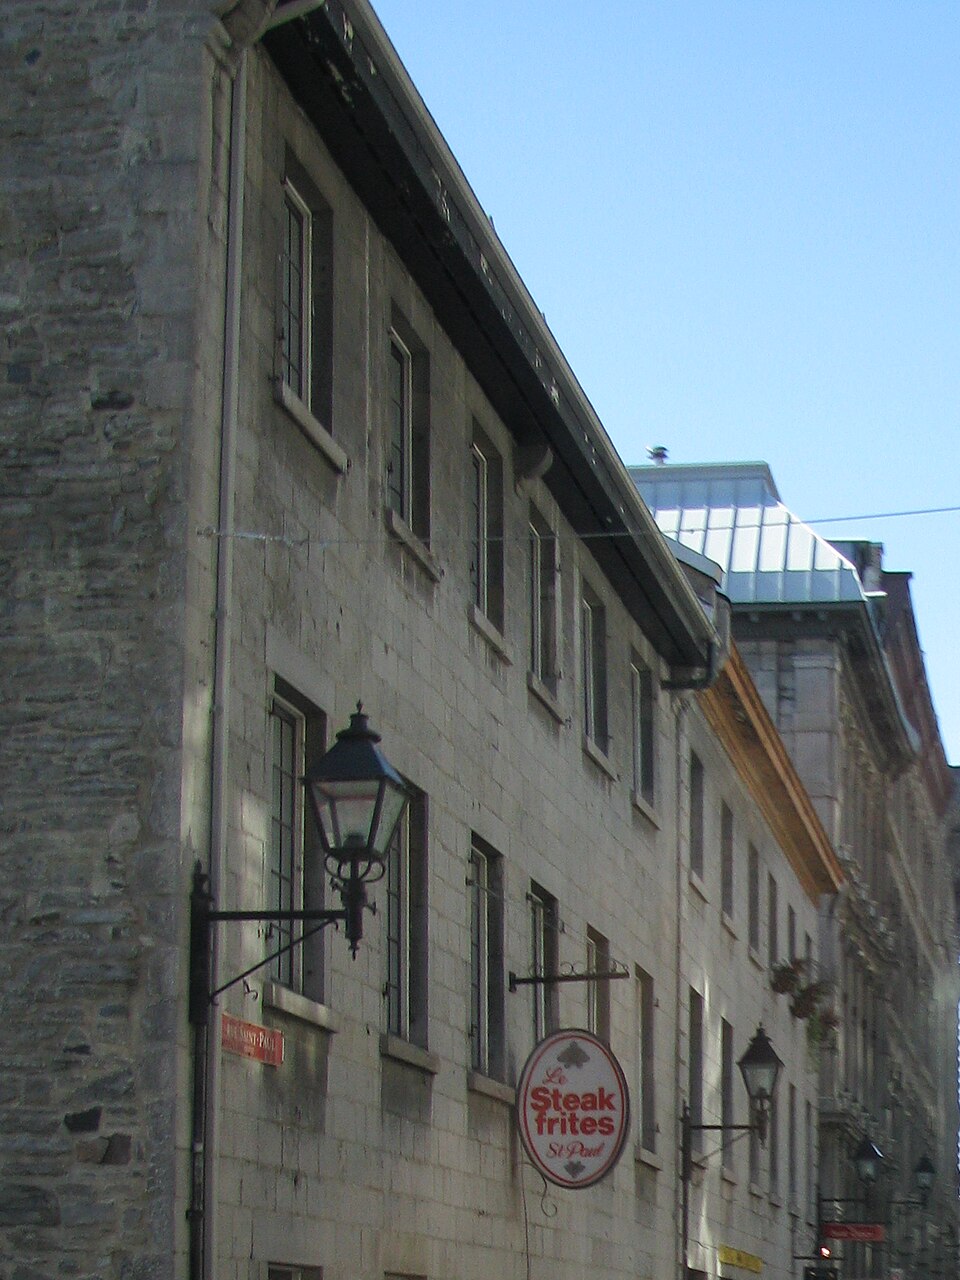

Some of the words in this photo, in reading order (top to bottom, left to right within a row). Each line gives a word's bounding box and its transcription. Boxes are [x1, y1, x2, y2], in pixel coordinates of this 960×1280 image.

[542, 1067, 567, 1085] Le
[530, 1086, 616, 1111] Steak
[535, 1110, 614, 1136] frites
